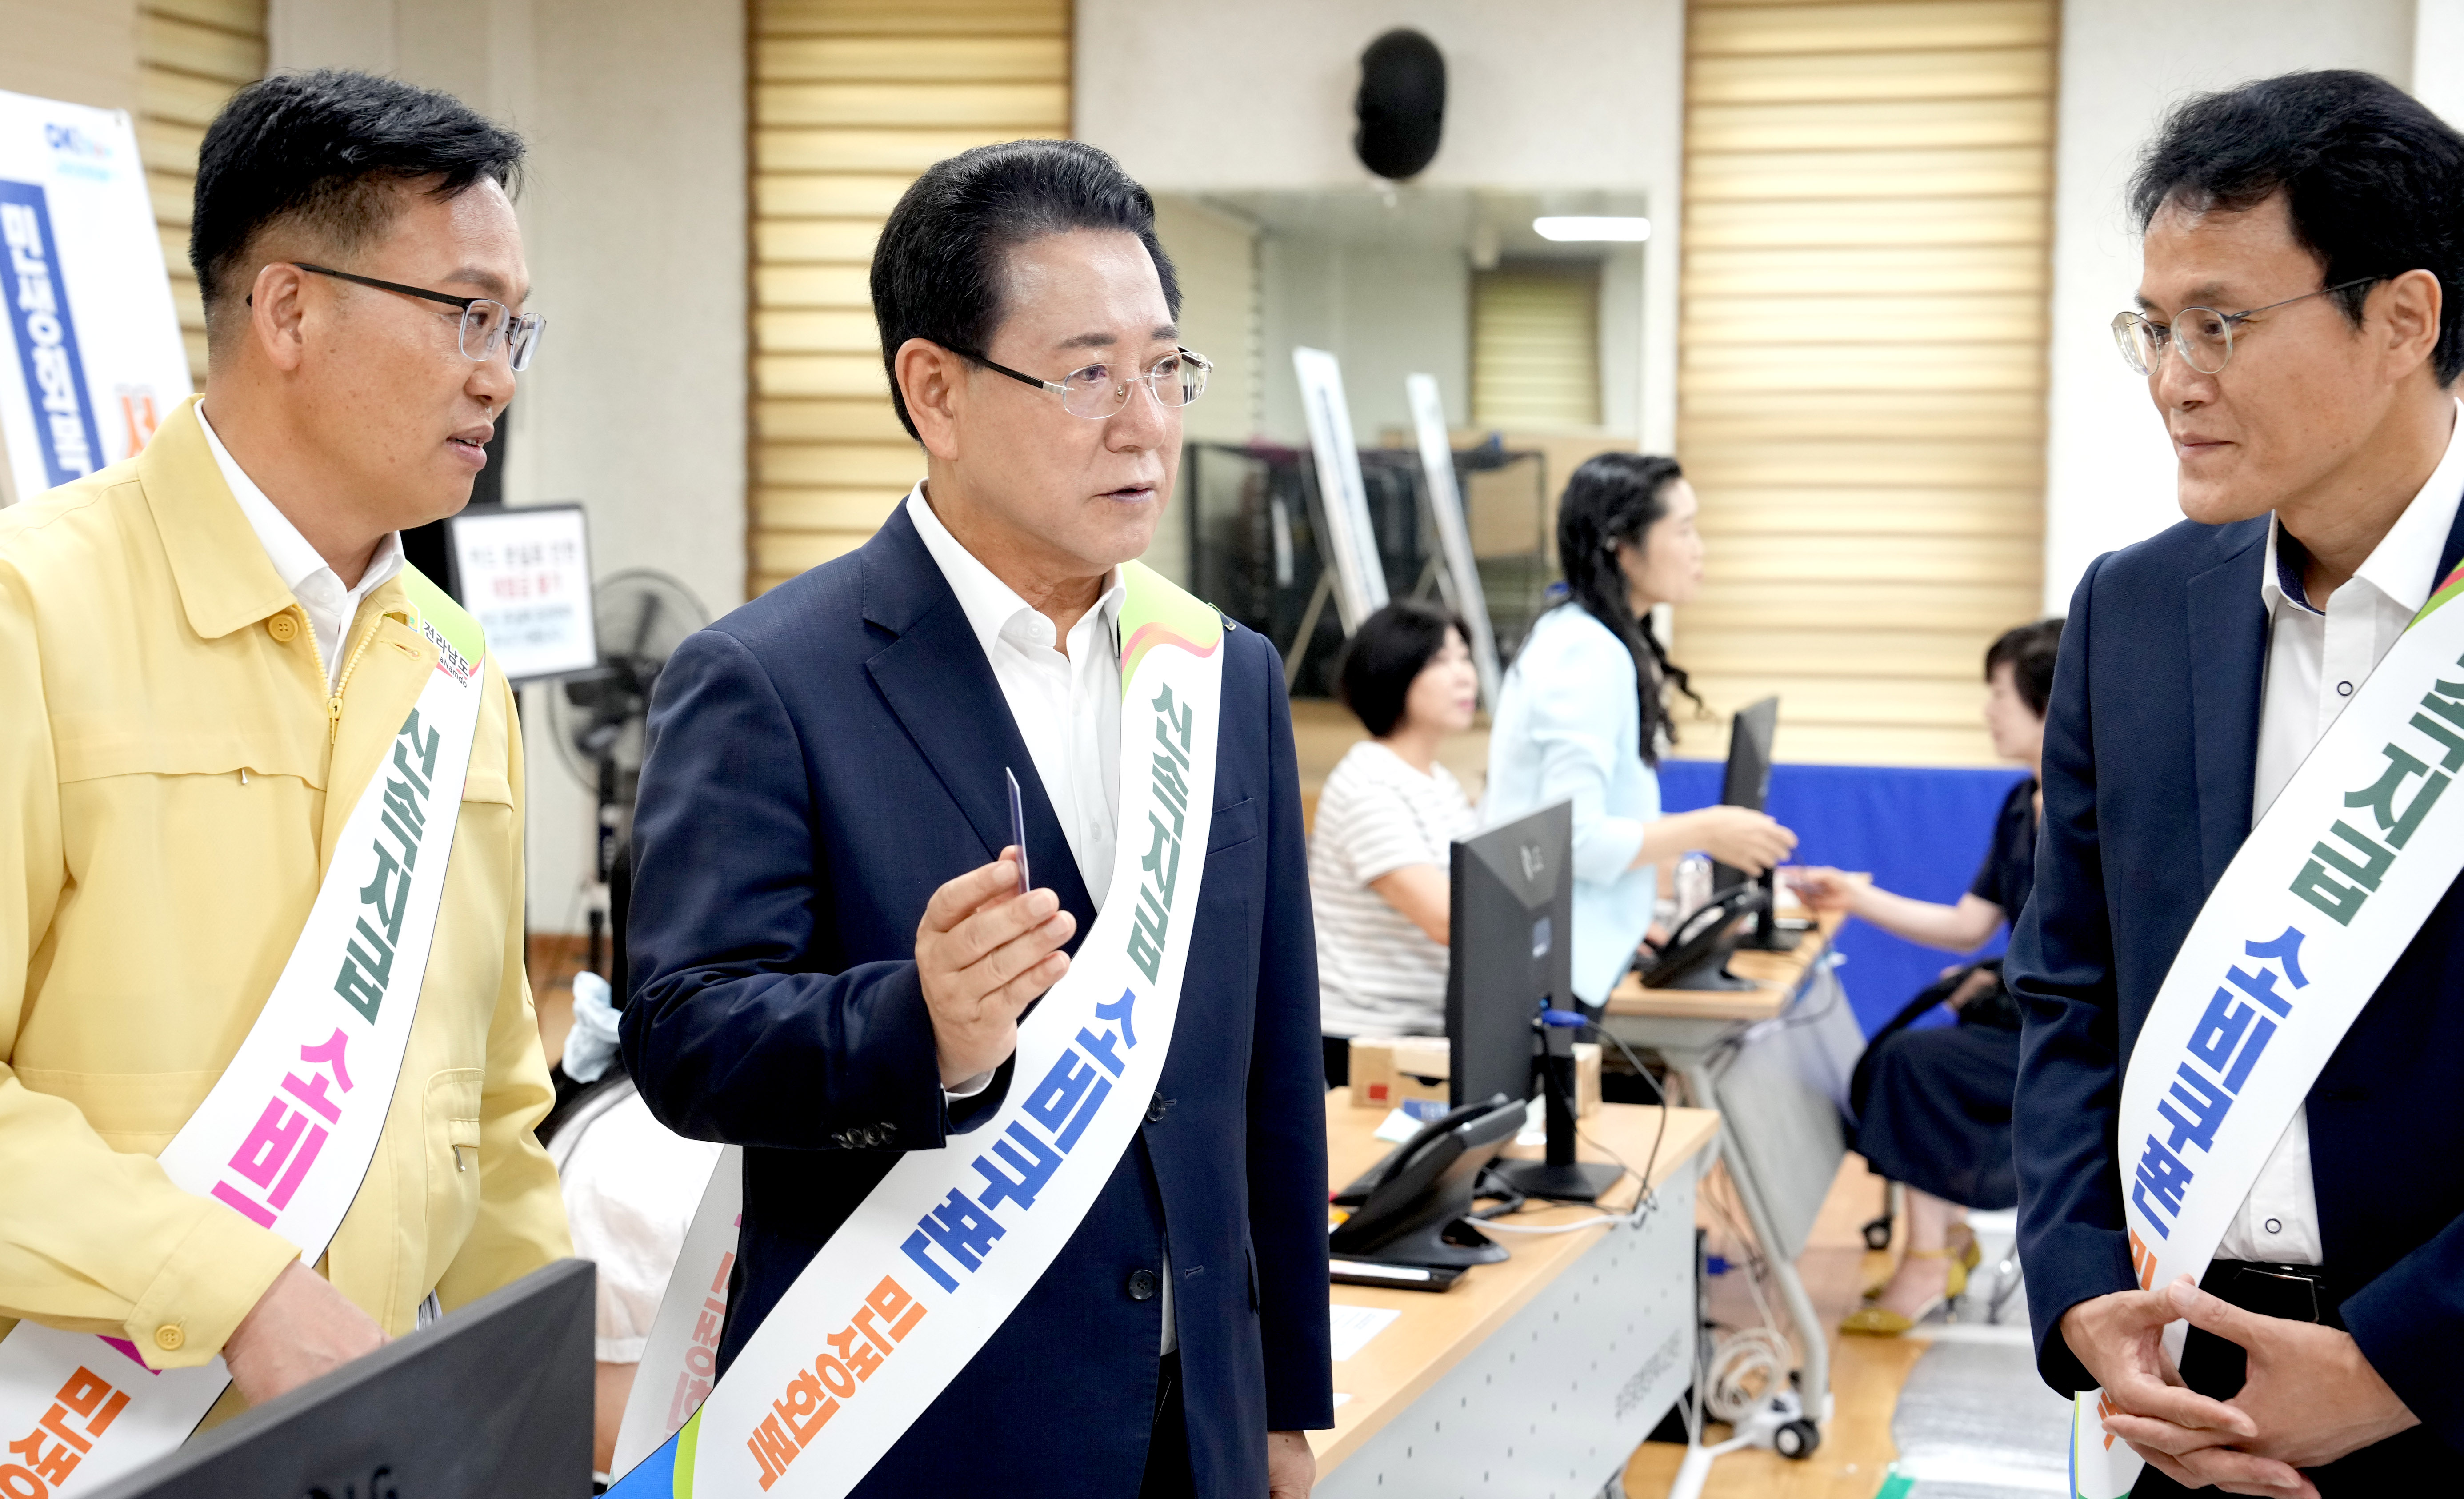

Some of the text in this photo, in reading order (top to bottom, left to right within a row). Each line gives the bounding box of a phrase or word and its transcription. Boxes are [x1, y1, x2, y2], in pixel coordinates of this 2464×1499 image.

[424, 621, 468, 677] 전라남도
[439, 656, 467, 688] aNamdo
[334, 706, 440, 1026] 신속지급
[210, 1027, 354, 1230] 소비
[747, 681, 1192, 1493] 신속지급 소비쿠폰 민생회복
[2132, 926, 2309, 1240] 소비쿠폰
[0, 1365, 131, 1499] 민생
